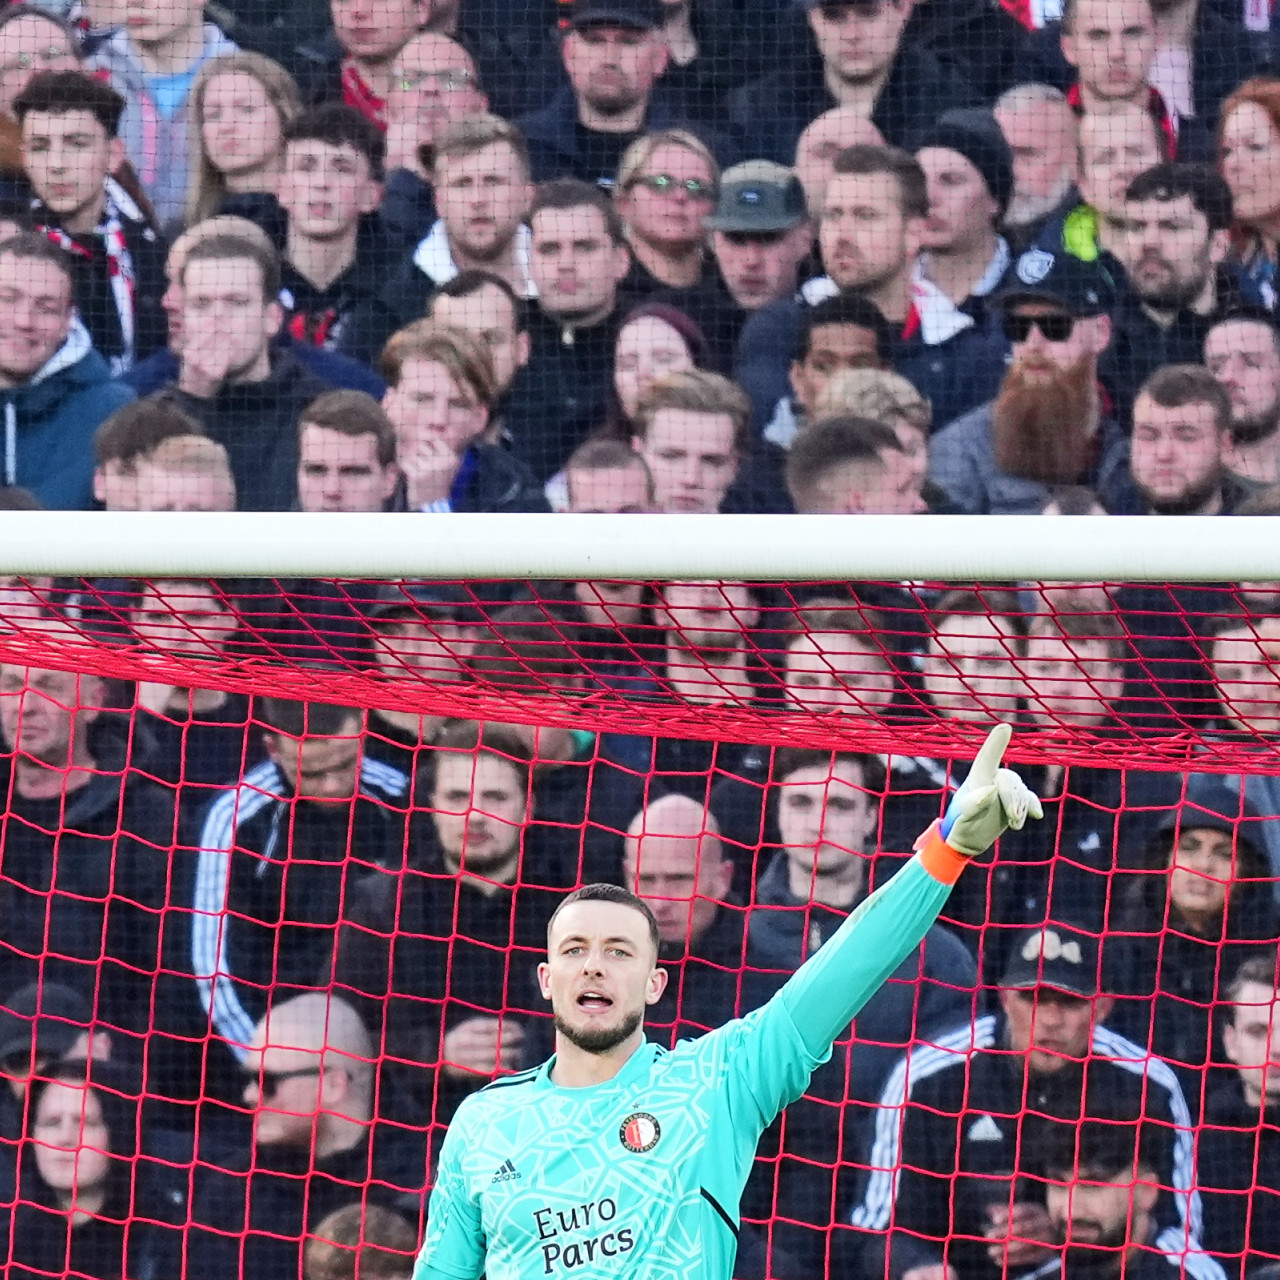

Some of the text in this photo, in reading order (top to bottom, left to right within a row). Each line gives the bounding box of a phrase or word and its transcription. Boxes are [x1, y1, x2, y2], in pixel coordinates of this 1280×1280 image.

[491, 1172, 522, 1184] adidas
[533, 1198, 616, 1240] Euro
[542, 1228, 634, 1275] Parcs
